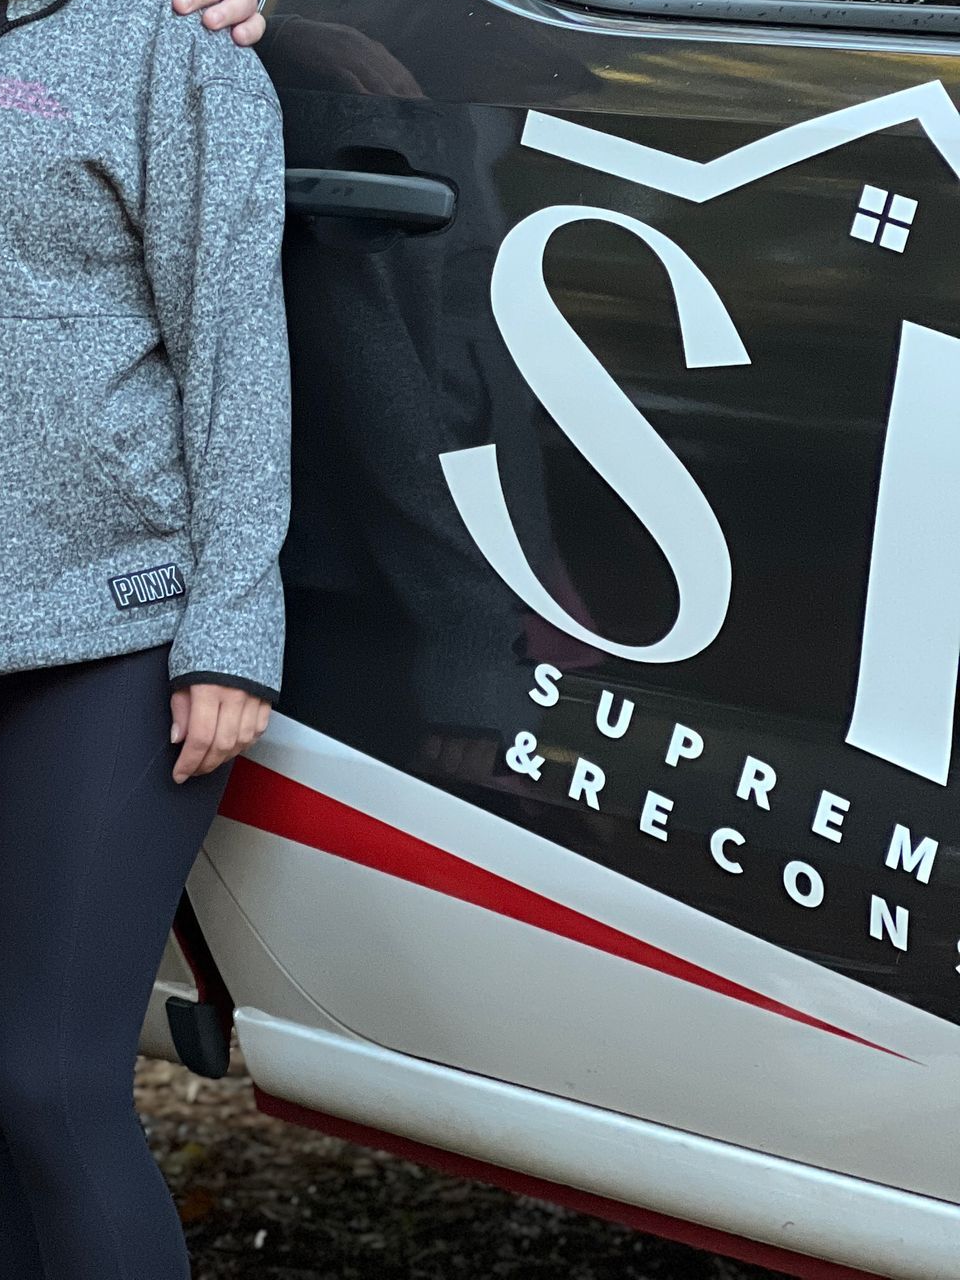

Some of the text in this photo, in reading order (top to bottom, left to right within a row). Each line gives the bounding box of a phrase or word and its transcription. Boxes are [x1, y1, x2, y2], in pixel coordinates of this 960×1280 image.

[113, 565, 183, 606] PINK
[506, 731, 960, 973] &RECON
[529, 663, 939, 885] SUPREM
